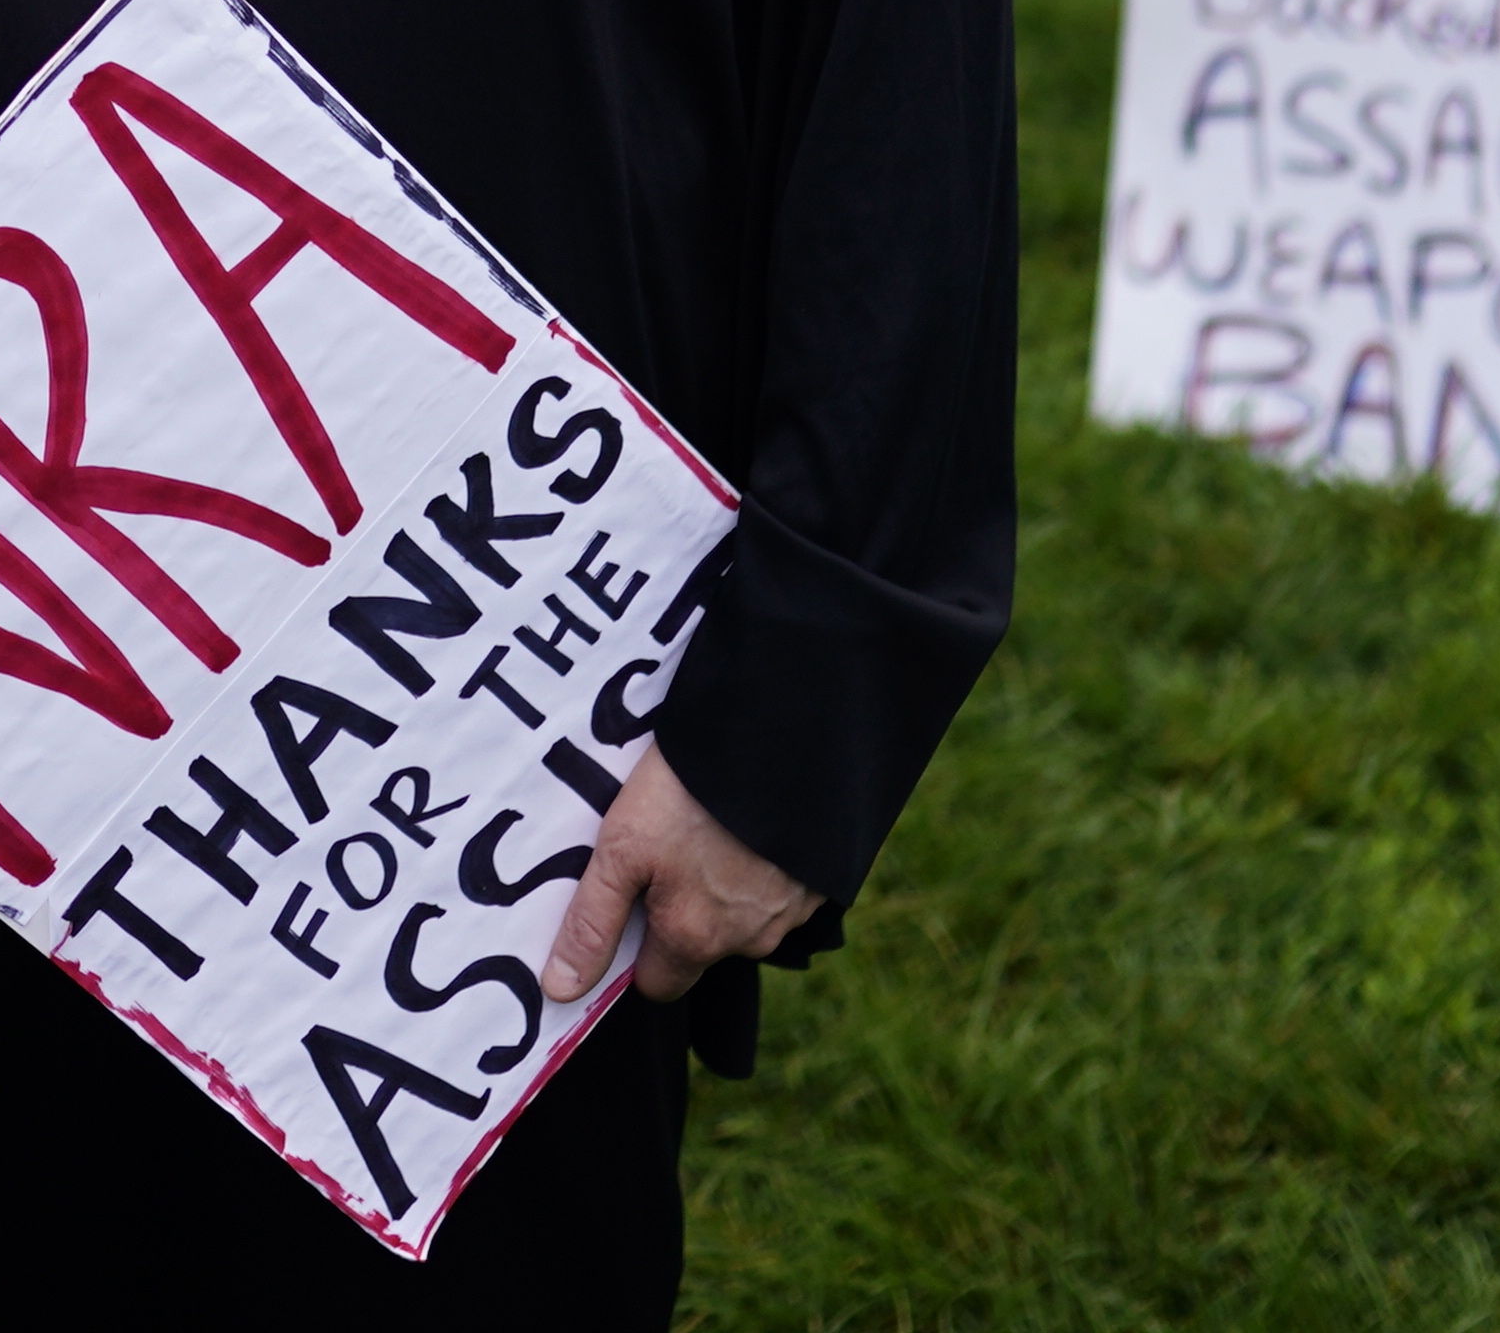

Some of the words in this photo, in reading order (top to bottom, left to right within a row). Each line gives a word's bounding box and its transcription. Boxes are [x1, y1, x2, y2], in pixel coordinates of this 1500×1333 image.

[62, 375, 624, 981] THANKS
[270, 764, 467, 979] FOR
[459, 530, 650, 731] THE
